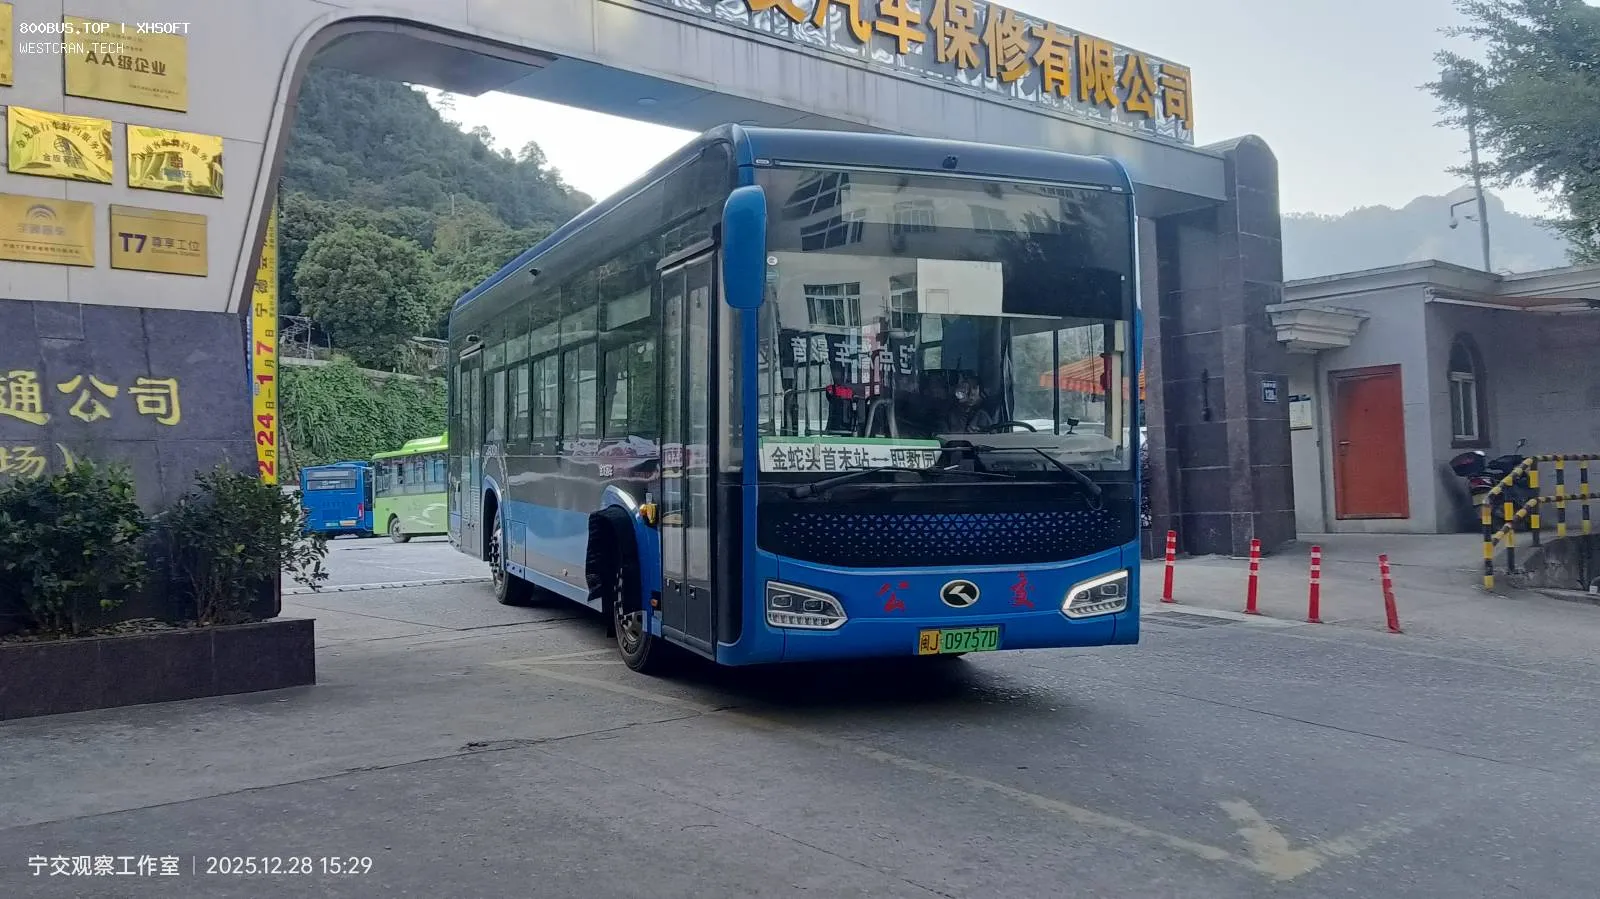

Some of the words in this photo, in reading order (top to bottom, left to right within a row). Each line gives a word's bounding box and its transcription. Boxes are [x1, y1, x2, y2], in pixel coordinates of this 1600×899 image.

[84, 49, 167, 76] AA级企业
[118, 232, 147, 253] T7
[0, 370, 181, 426] 通公司
[771, 445, 870, 471] 金蛇头首末站
